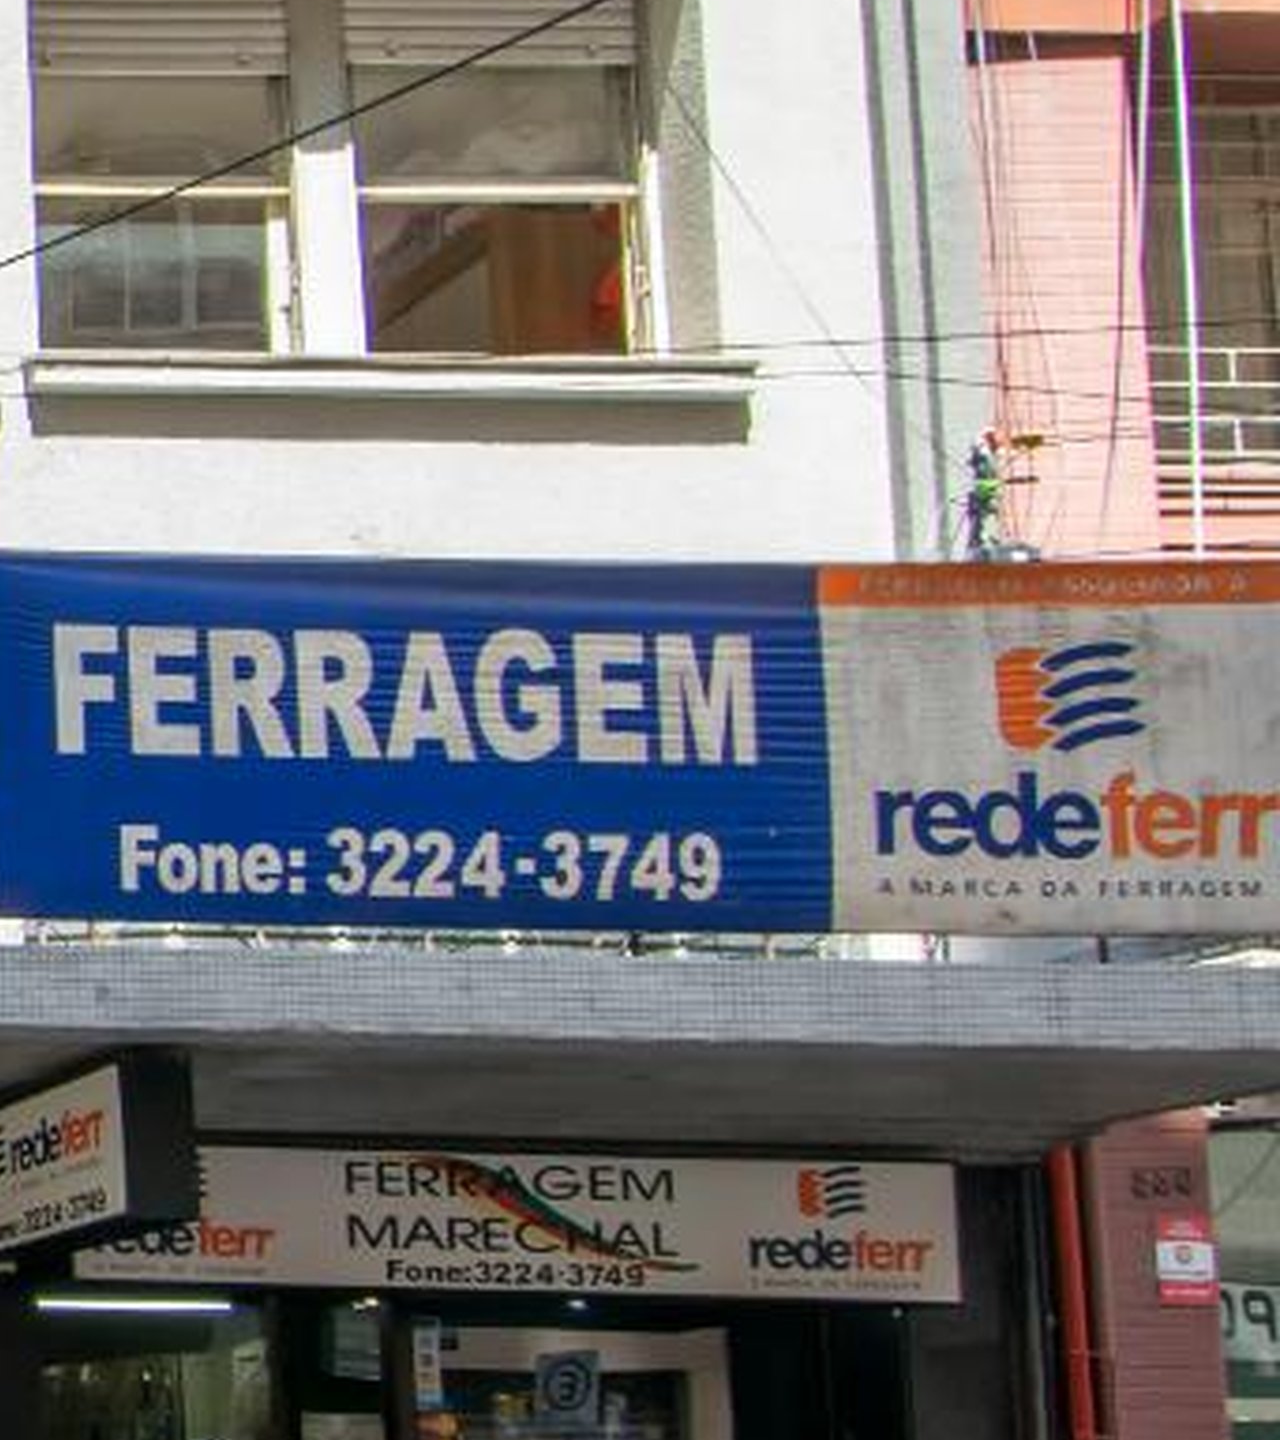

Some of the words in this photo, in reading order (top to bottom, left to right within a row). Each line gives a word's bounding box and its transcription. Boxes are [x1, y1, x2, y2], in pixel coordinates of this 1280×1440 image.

[52, 621, 759, 767] FERRAGEM
[874, 766, 1280, 860] redeferr
[119, 822, 307, 895] Fone:
[325, 826, 722, 901] 3224-3749
[10, 1109, 104, 1174] redeferr
[344, 1159, 676, 1205] FERRAGEM
[345, 1216, 680, 1258] MARECHAL
[747, 1230, 935, 1271] redeferr
